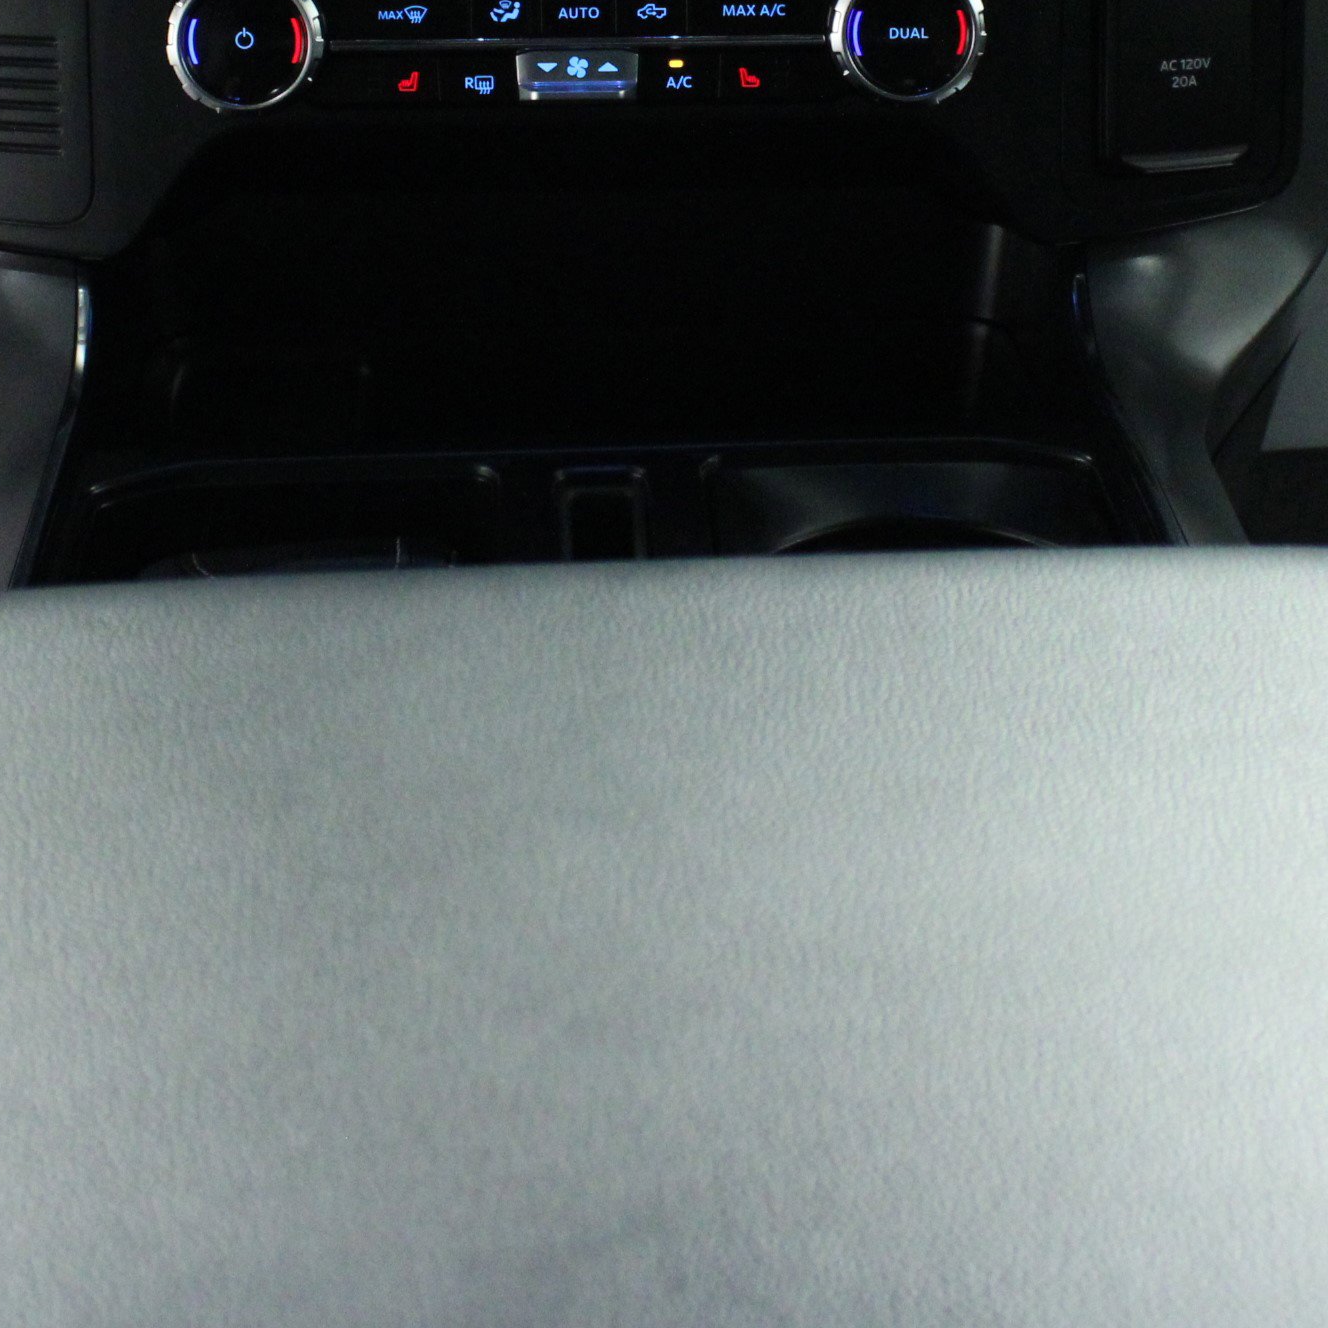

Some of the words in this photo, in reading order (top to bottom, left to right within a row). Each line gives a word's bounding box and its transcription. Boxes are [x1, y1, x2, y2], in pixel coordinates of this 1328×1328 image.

[378, 10, 404, 20] MAX
[558, 7, 600, 19] AUTO
[722, 4, 755, 16] MAX
[760, 3, 786, 17] A/C
[889, 27, 929, 39] DUAL
[1160, 59, 1177, 72] AC
[1180, 57, 1211, 70] 120V
[666, 76, 692, 89] A/C
[1171, 76, 1197, 88] 20A
